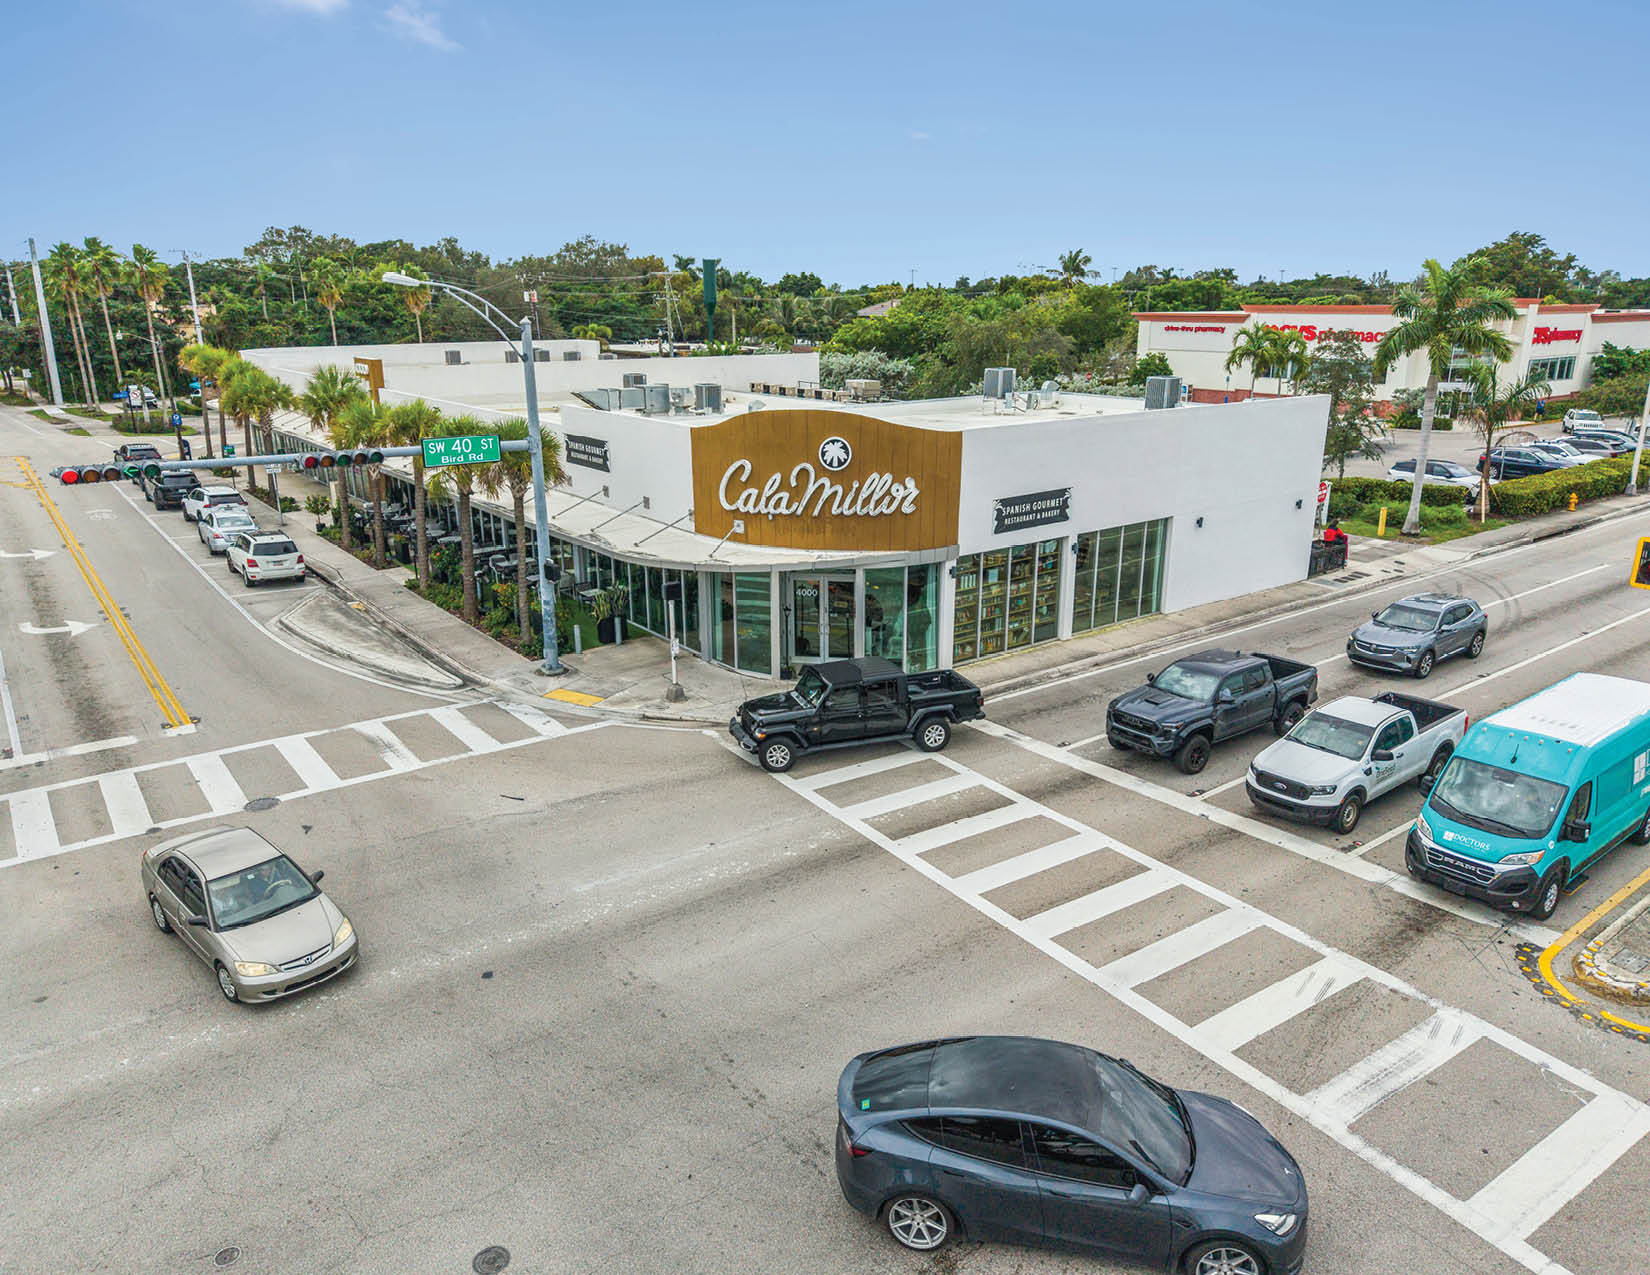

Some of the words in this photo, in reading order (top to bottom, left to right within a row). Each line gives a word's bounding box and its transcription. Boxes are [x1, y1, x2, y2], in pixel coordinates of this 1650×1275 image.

[1194, 326, 1226, 334] pharmacy
[428, 441, 445, 454] SW
[451, 438, 472, 453] 40
[480, 438, 494, 450] ST
[441, 454, 464, 463] Bird
[468, 453, 484, 461] Rd
[719, 459, 798, 516] Cala
[790, 462, 920, 517] Millor
[1002, 503, 1031, 516] SPANISH
[1032, 498, 1063, 511] GOURMET
[1004, 514, 1036, 525] RESTAURANT
[1041, 509, 1060, 518] BAKERY
[796, 588, 818, 597] 4000
[1453, 833, 1490, 851] DOCTORS
[1444, 856, 1476, 871] RAM
